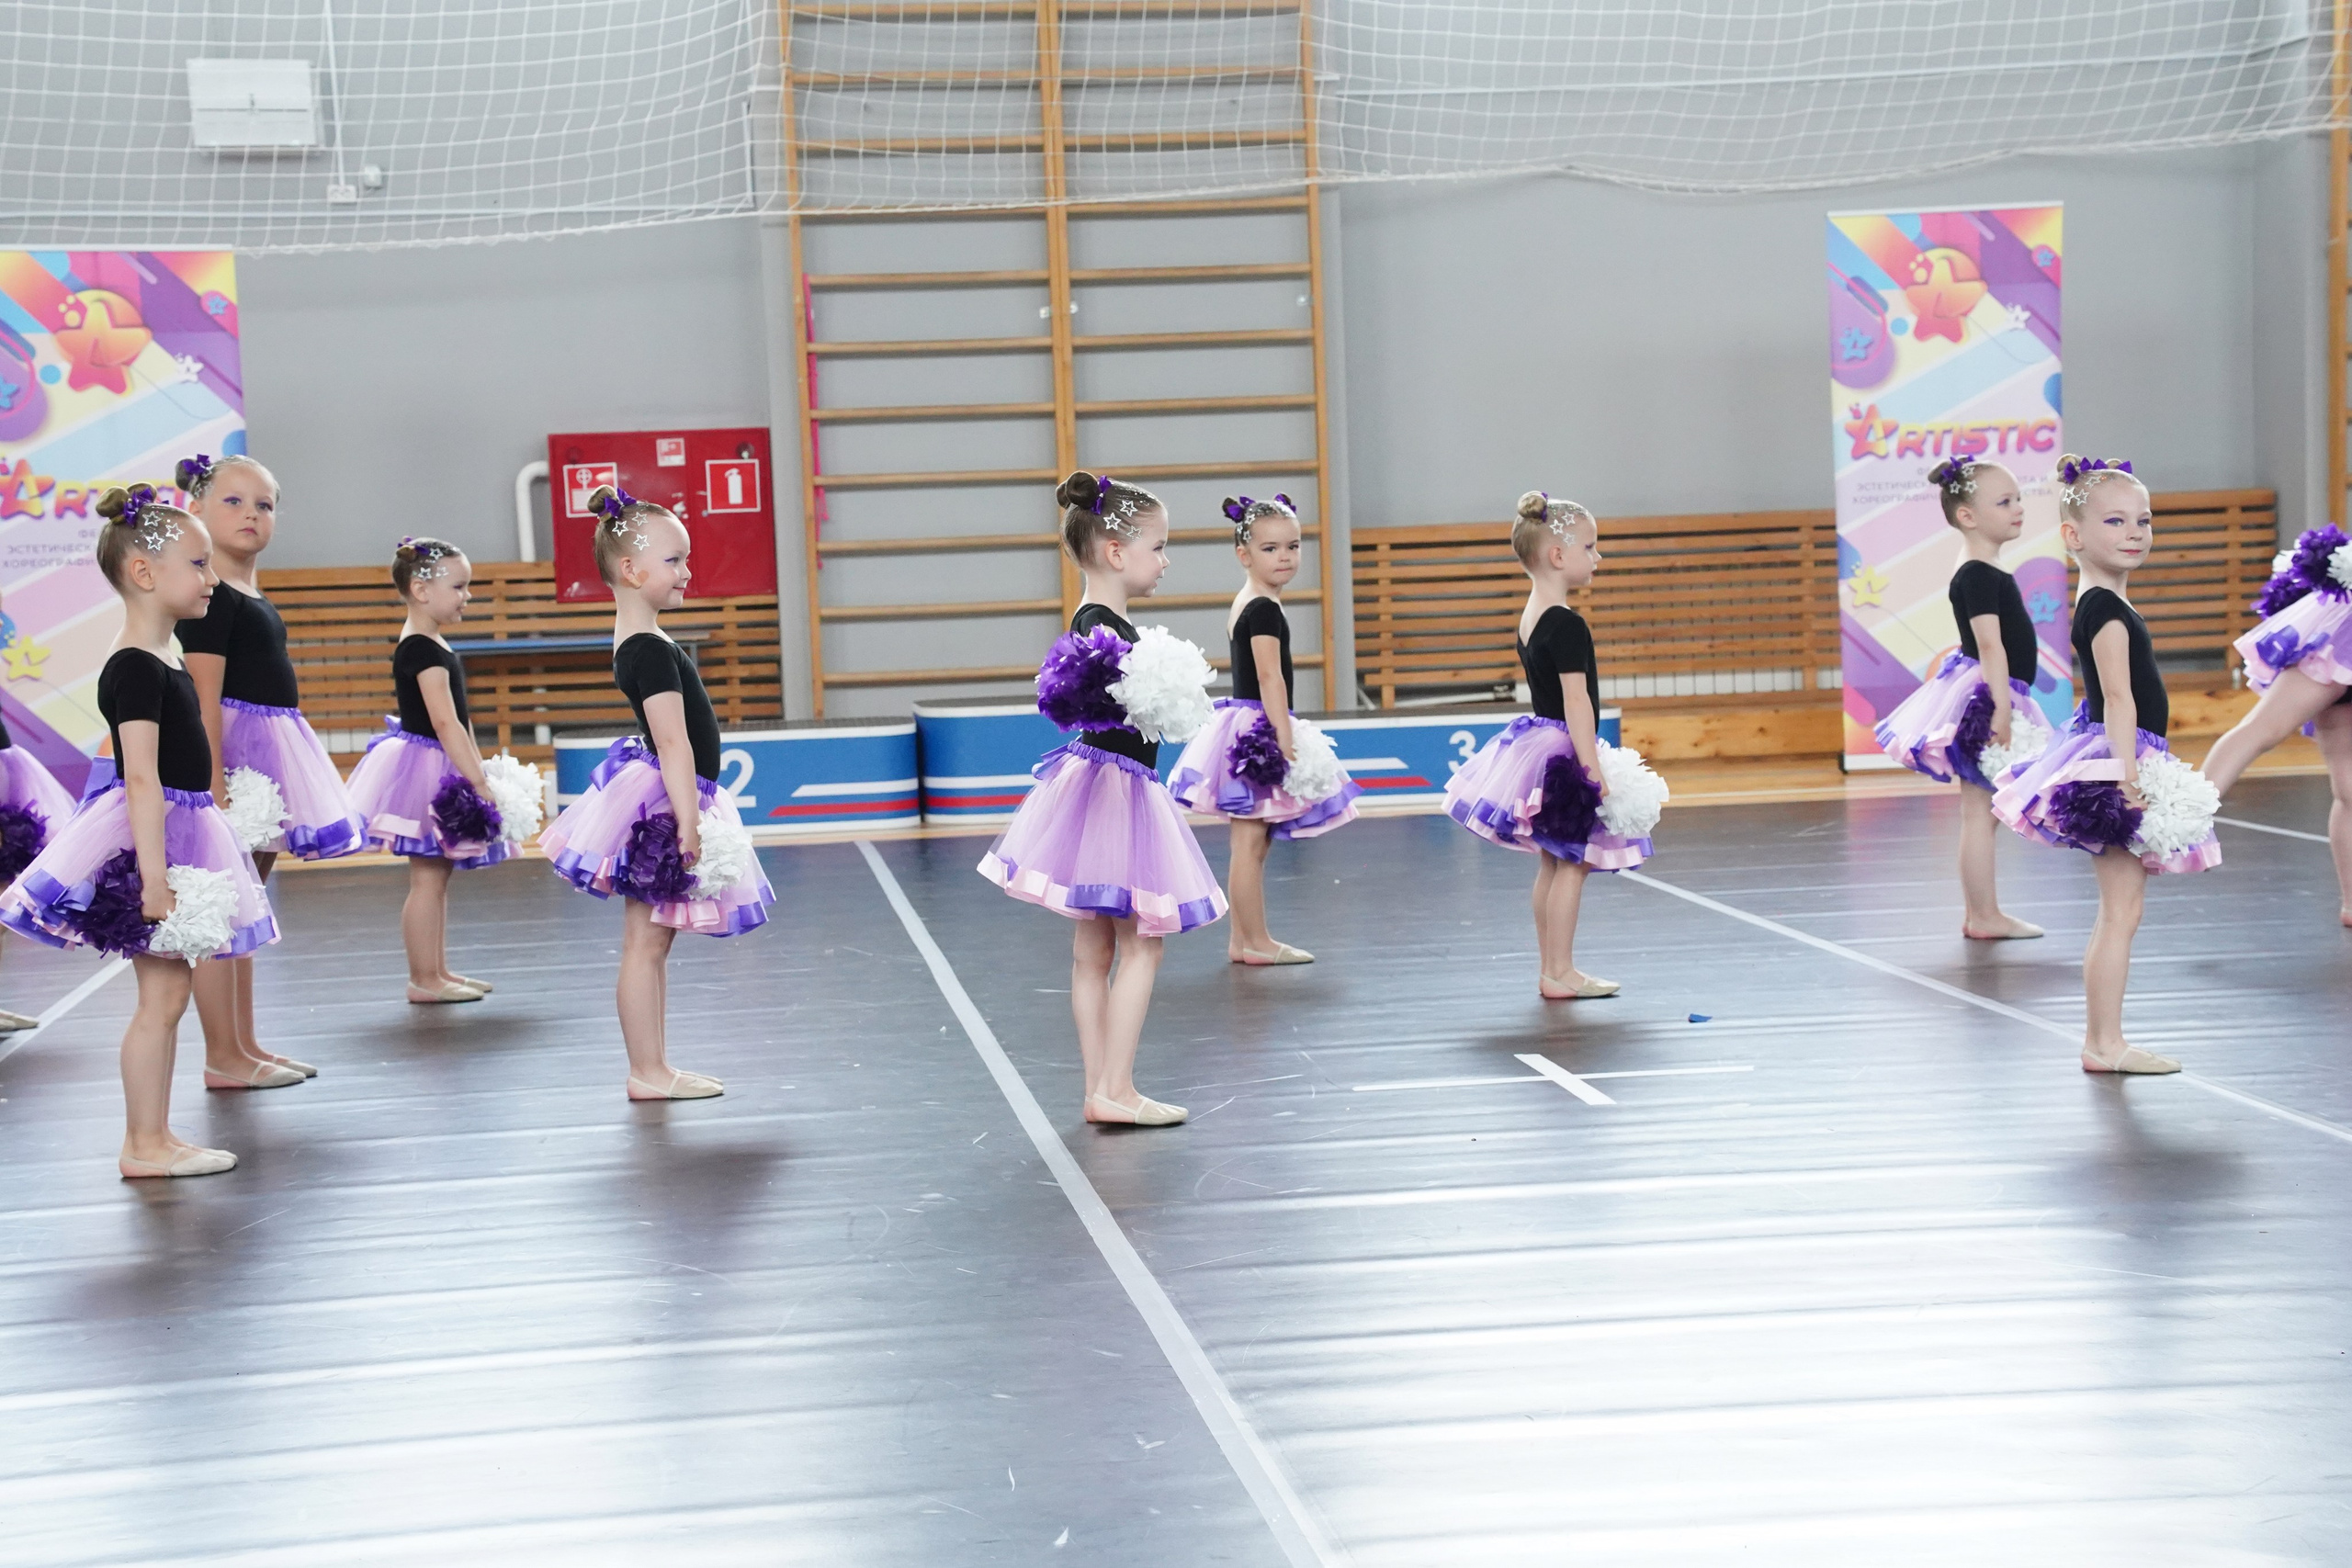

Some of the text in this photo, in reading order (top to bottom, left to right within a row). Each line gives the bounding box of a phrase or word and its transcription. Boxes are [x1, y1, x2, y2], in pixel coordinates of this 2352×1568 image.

[1844, 403, 2057, 459] ARTISTIC
[719, 748, 757, 808] 2
[1448, 729, 1476, 774] 3
